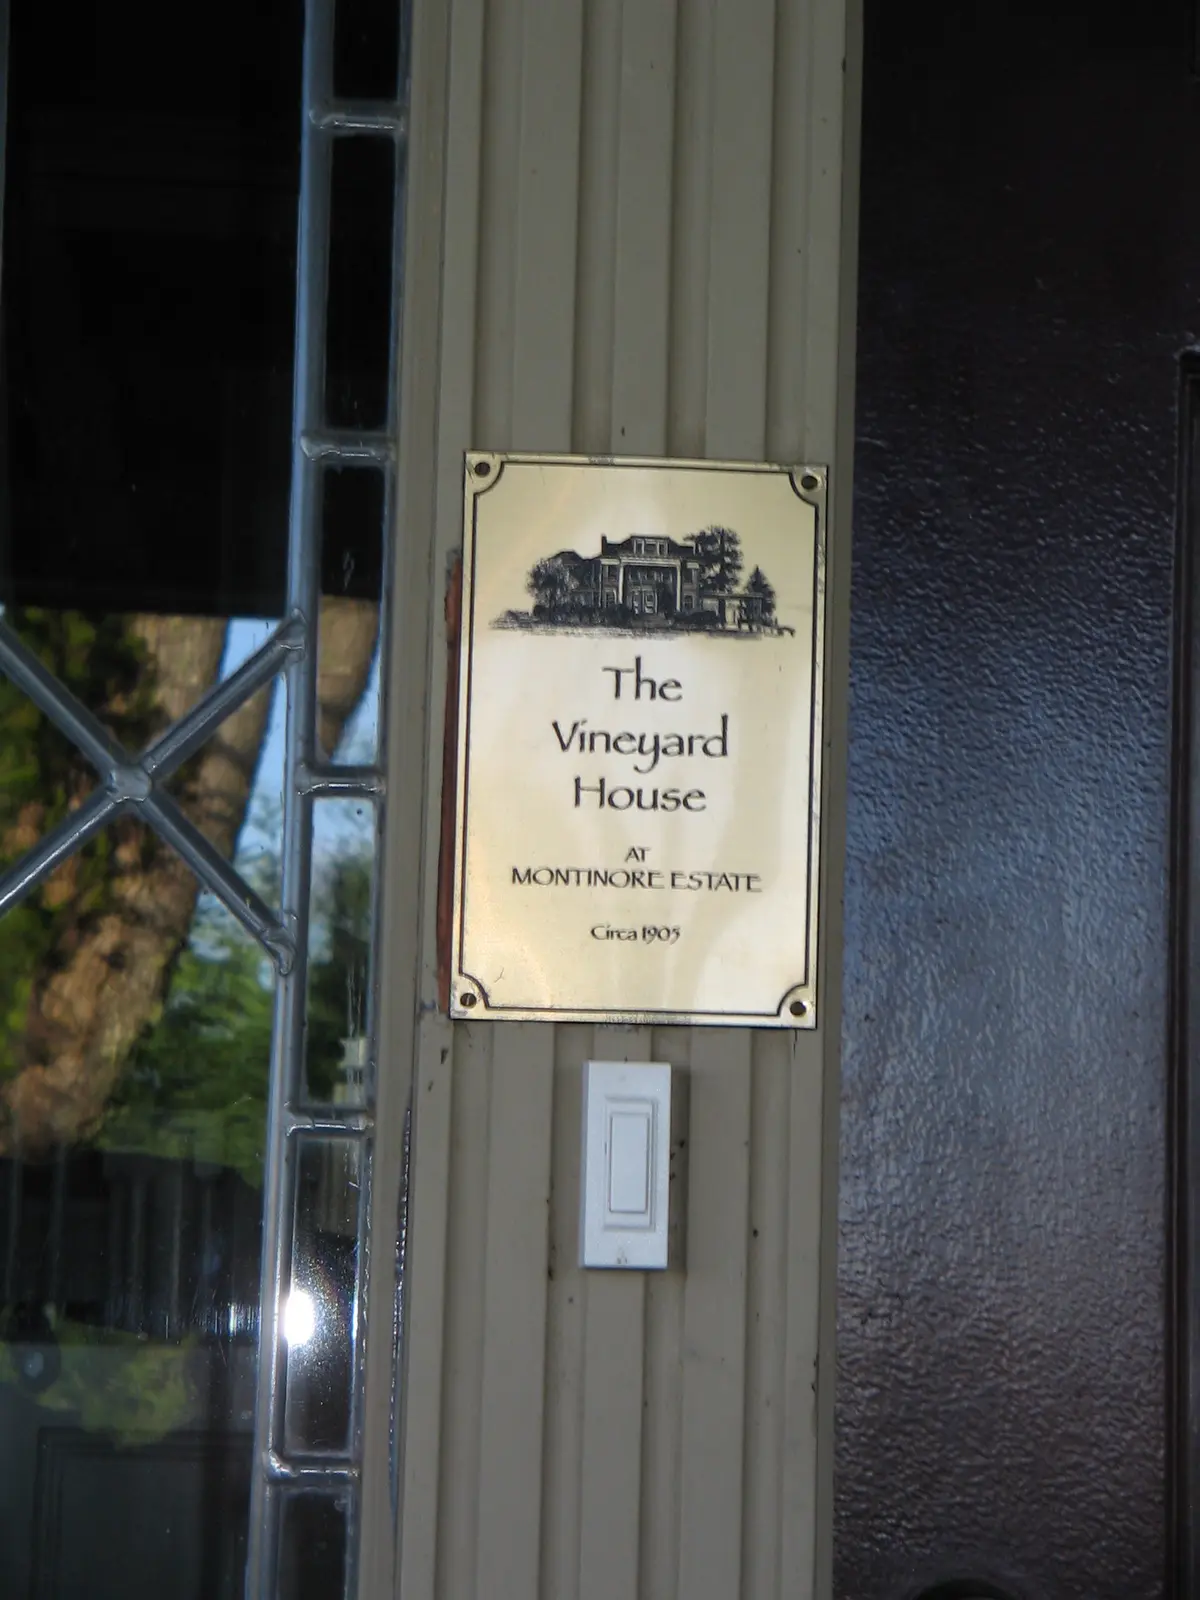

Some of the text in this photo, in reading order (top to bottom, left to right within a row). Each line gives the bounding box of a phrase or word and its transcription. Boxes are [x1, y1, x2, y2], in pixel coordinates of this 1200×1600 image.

[602, 655, 683, 701] The
[551, 713, 729, 774] Vineyard
[573, 776, 707, 812] House
[624, 846, 650, 864] AT
[511, 866, 763, 893] MONTINORE ESTATE
[590, 924, 681, 945] Circa 1905
